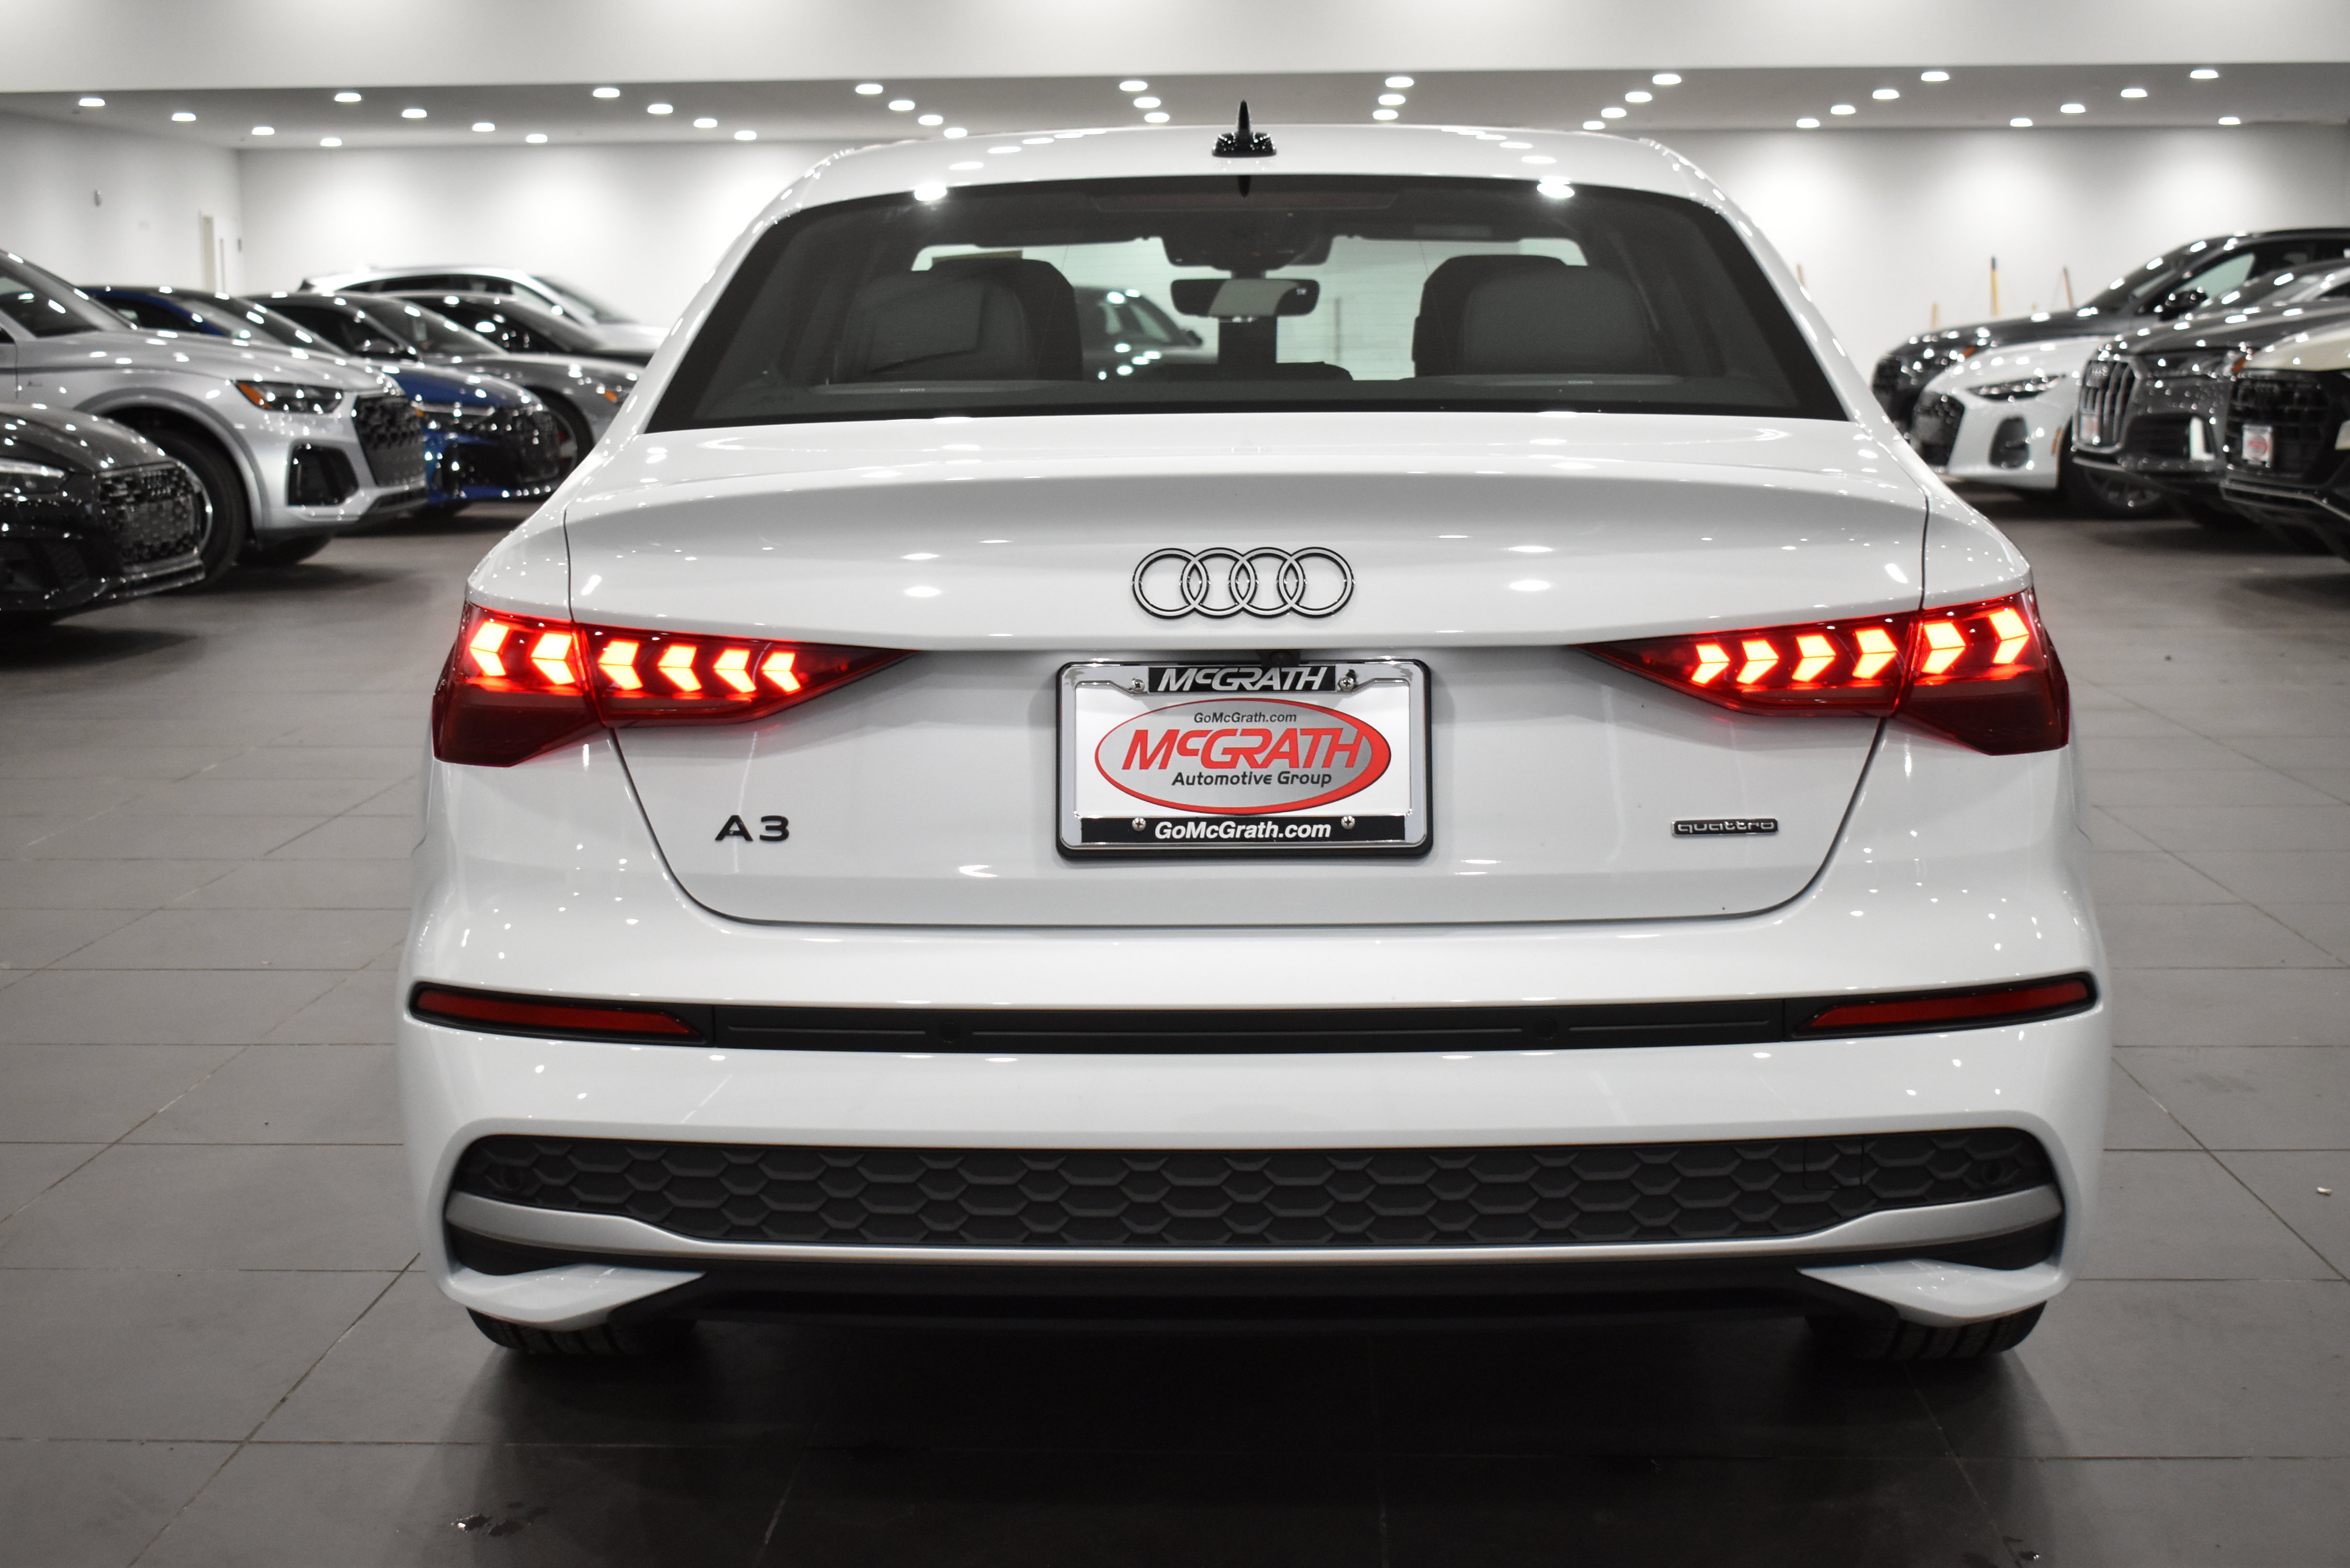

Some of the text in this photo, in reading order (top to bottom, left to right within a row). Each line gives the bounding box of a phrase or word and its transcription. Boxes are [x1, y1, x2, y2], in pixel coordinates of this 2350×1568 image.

[1194, 711, 1297, 724] GoMcGrath.com
[1171, 770, 1332, 788] Automotive Group
[715, 815, 790, 842] A3
[1155, 821, 1331, 840] GoMcGrath.com
[1678, 821, 1774, 834] quattro
